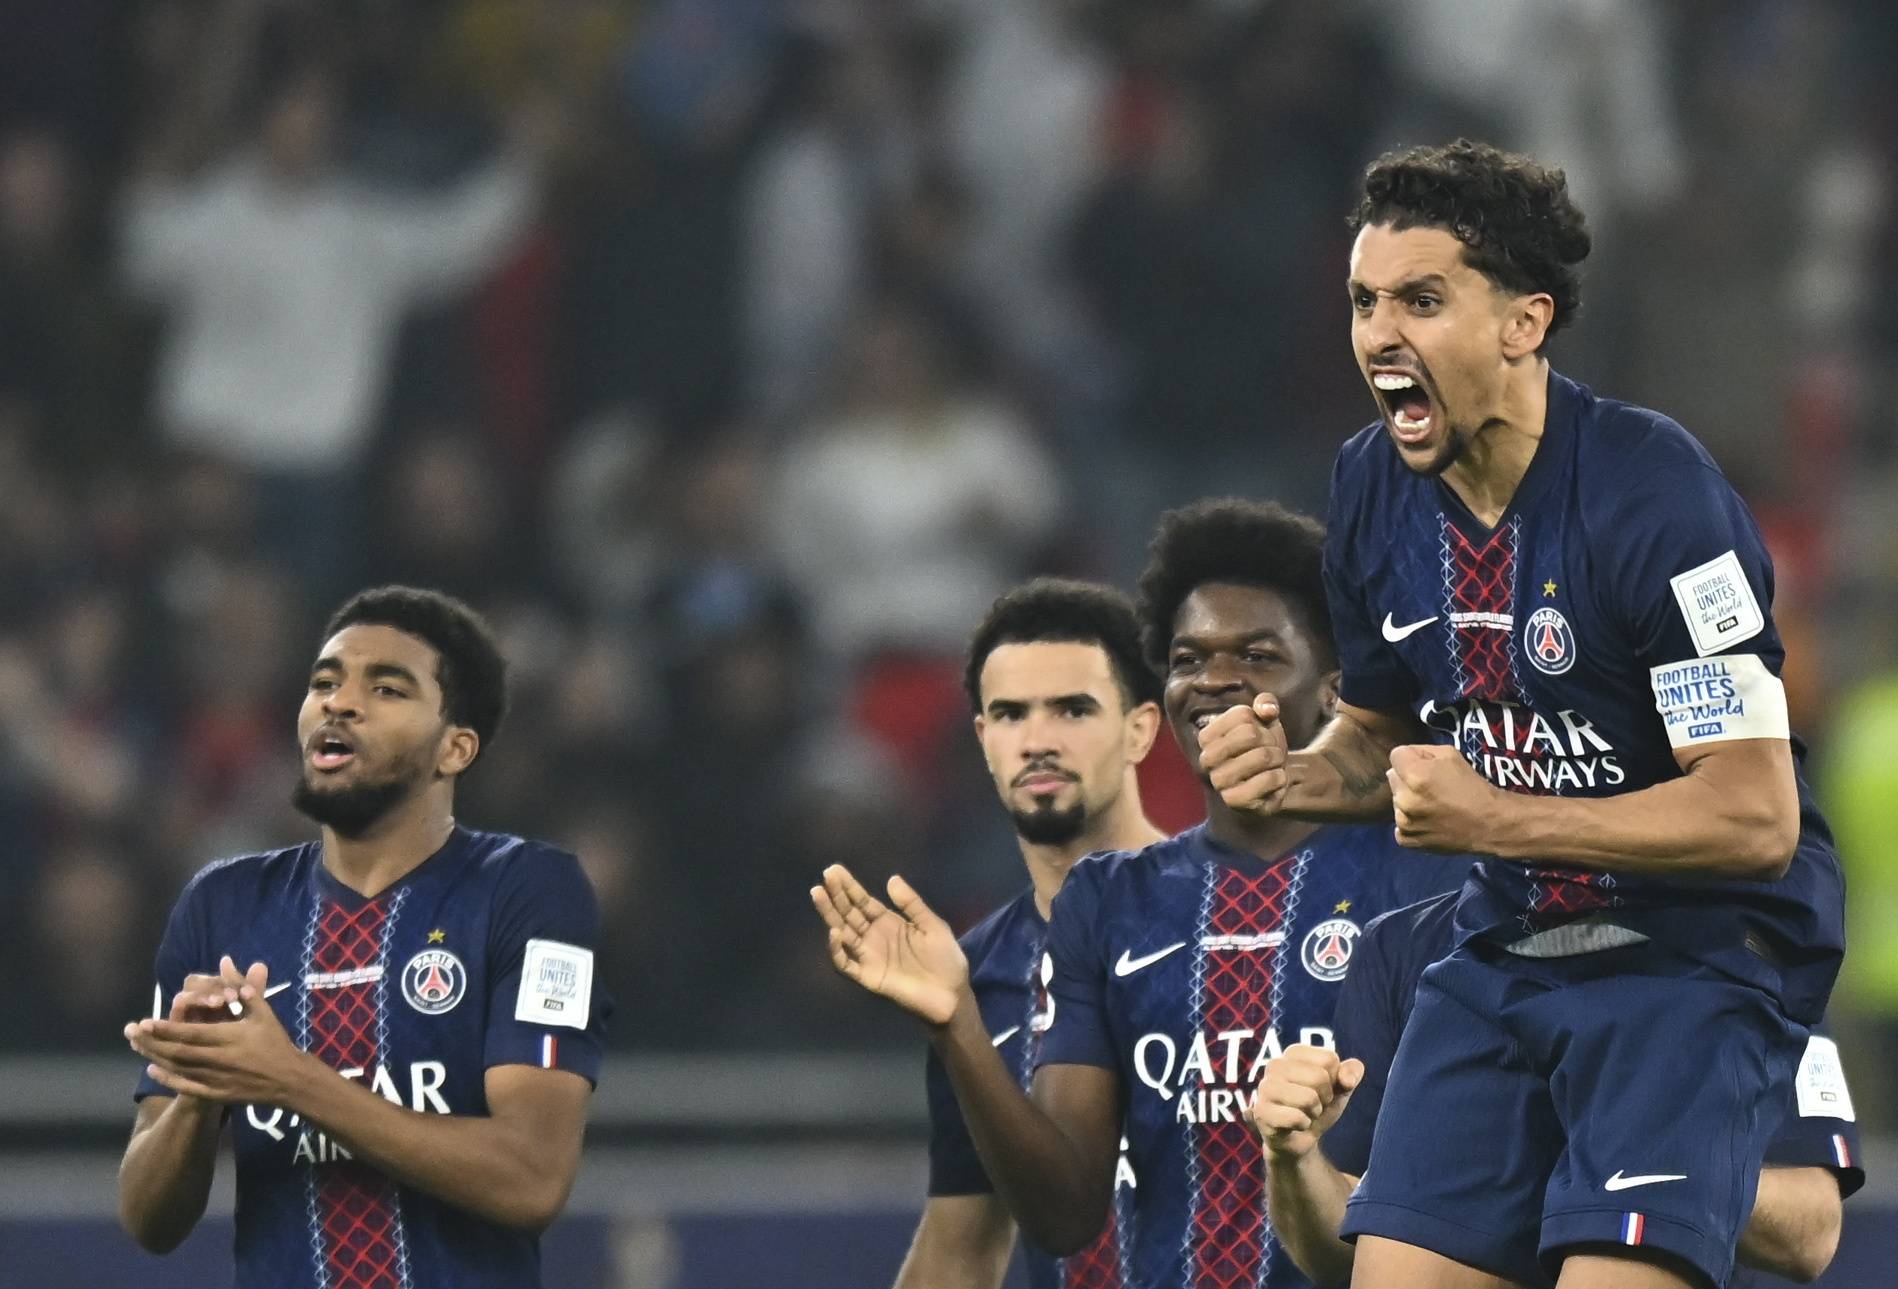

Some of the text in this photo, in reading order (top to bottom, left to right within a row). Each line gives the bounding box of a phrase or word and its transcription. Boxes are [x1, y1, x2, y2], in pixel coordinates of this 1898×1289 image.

[1692, 571, 1731, 597] FOOTBALL
[1696, 583, 1736, 611] UNITES
[1532, 611, 1564, 629] PARIS
[1656, 662, 1731, 687] FOOTBALL
[1658, 678, 1736, 708] UNITES
[1664, 698, 1744, 726] the World
[1689, 722, 1722, 738] FIFA
[1466, 751, 1626, 790] IRWAYS
[1315, 923, 1356, 939] PARIS
[412, 952, 455, 970] PARIS
